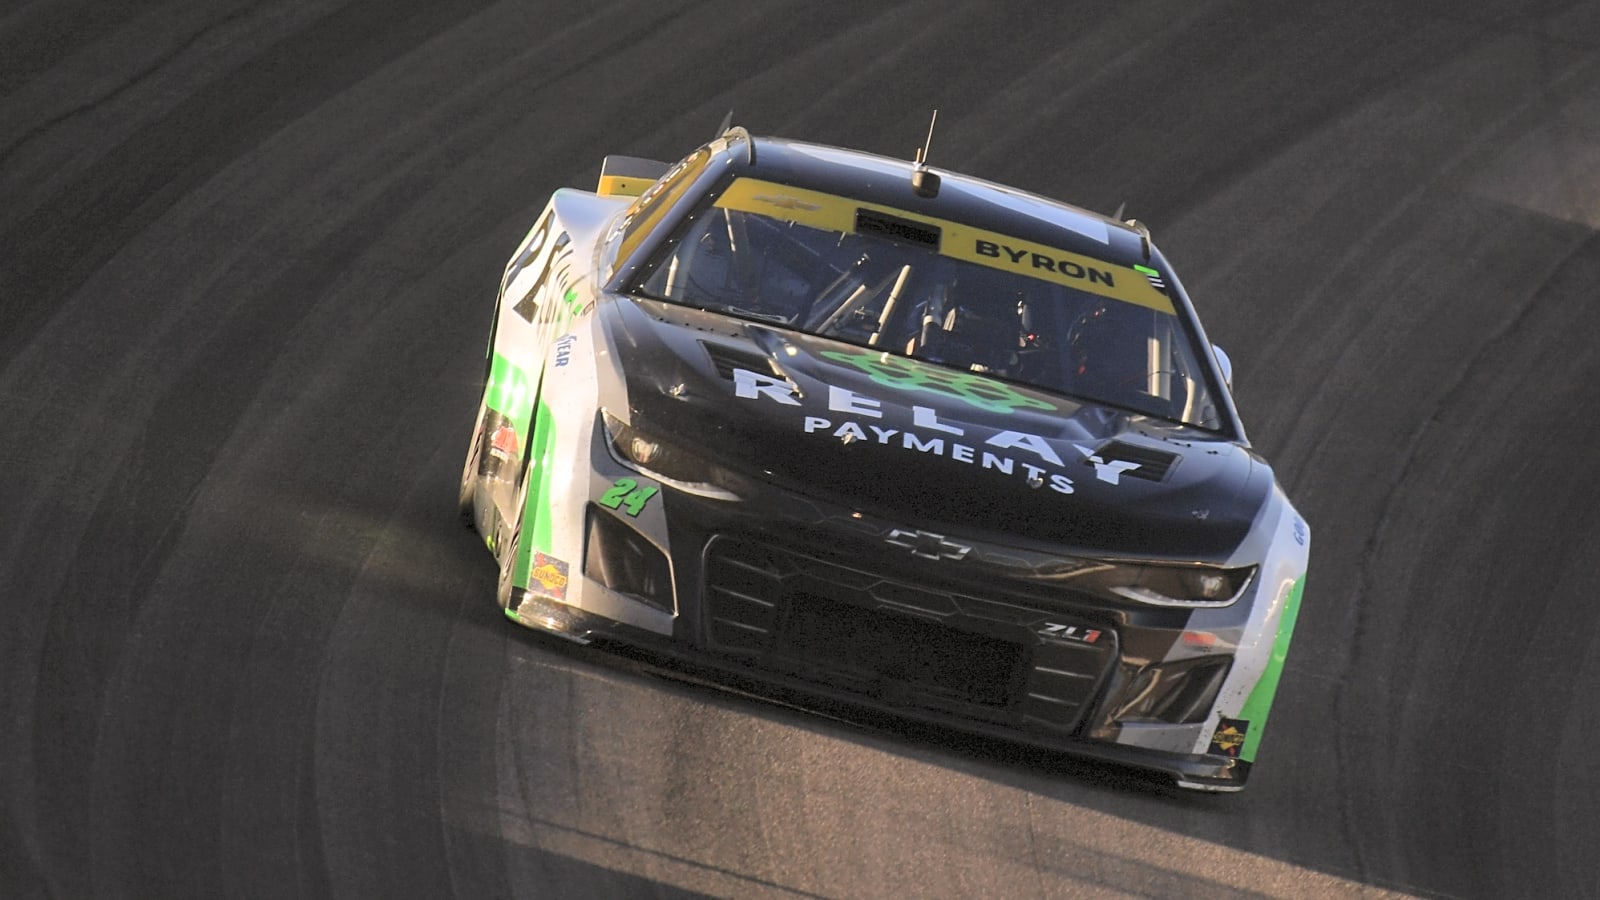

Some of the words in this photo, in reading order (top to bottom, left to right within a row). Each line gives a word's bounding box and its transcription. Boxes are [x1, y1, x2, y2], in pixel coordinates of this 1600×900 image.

[975, 239, 1115, 287] BYRON
[733, 368, 1142, 485] RELAY
[804, 416, 1075, 494] PAYMENTS
[599, 478, 659, 518] 24
[532, 567, 567, 587] SUNOCO
[1038, 622, 1102, 643] ZL1
